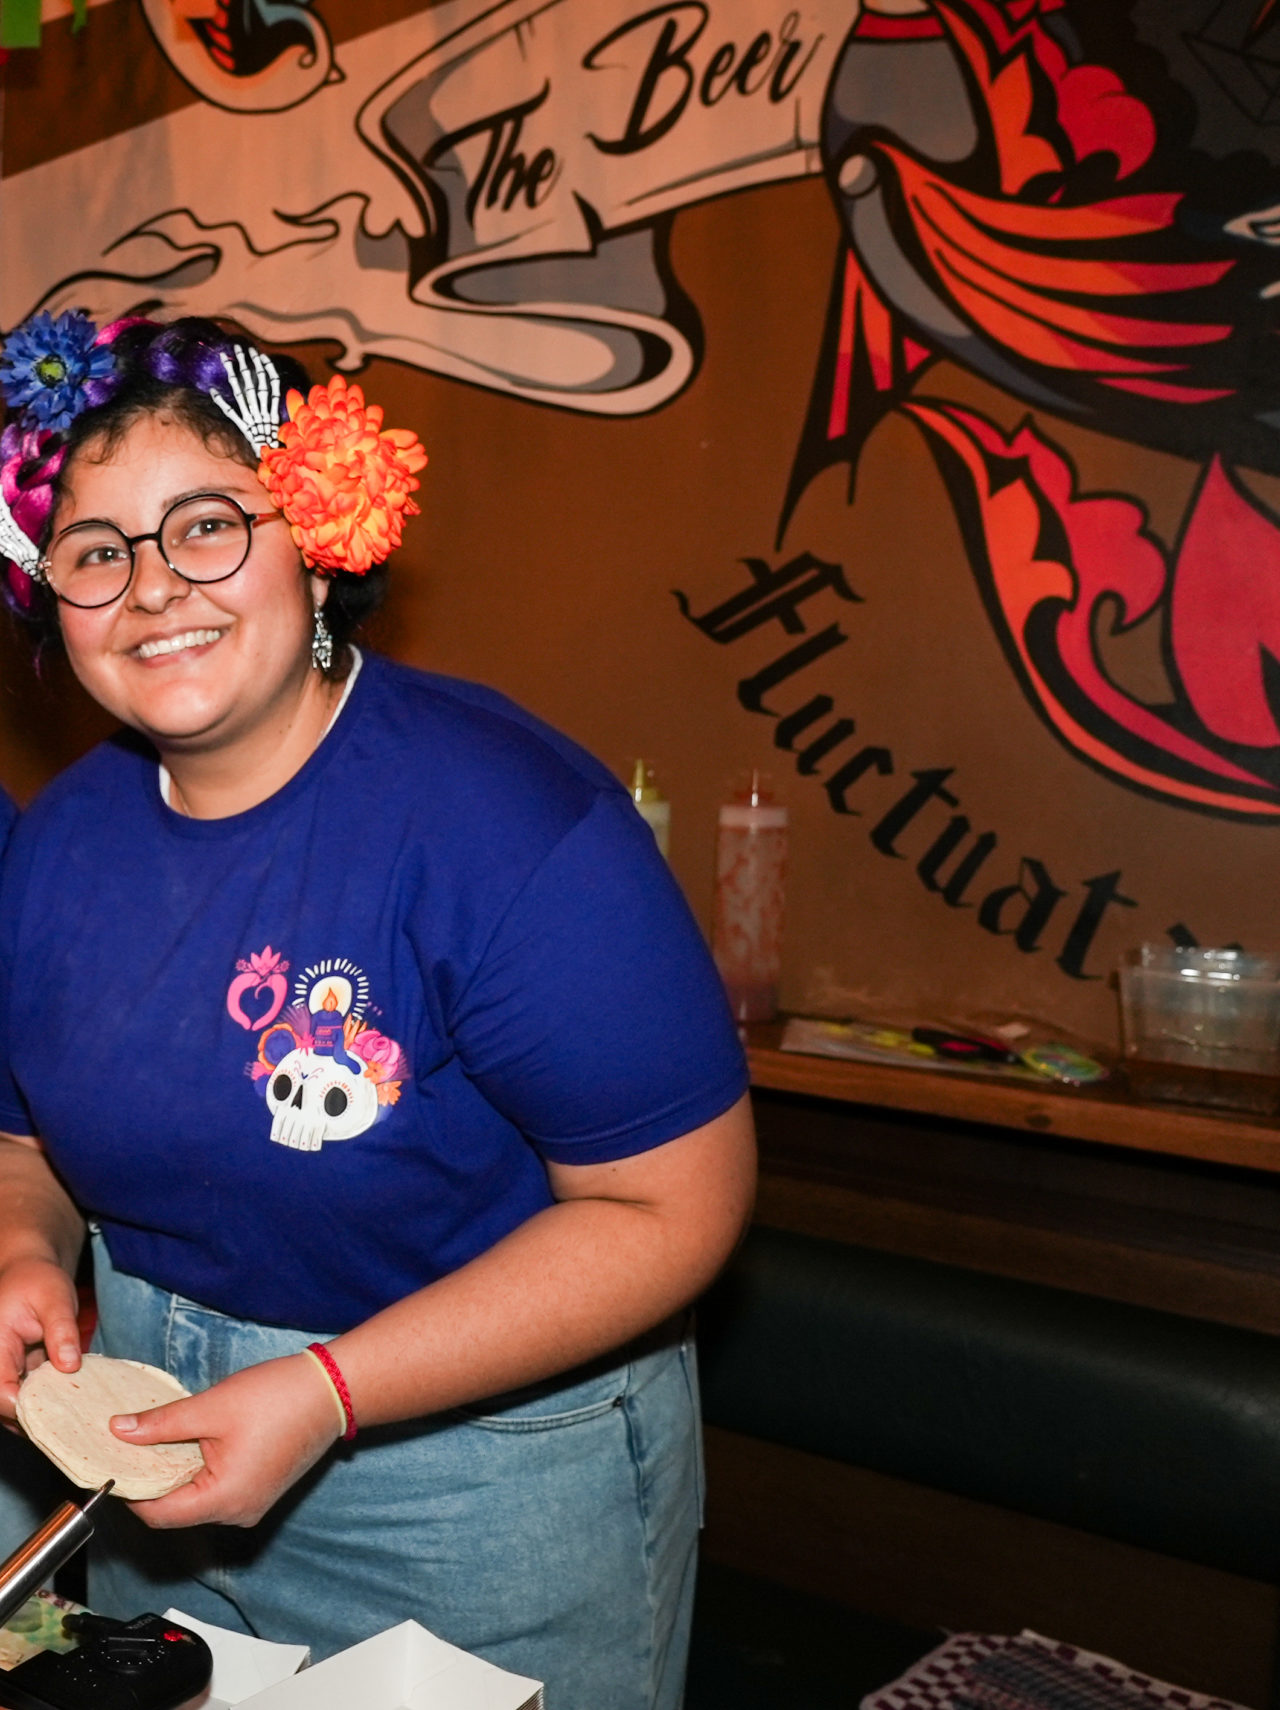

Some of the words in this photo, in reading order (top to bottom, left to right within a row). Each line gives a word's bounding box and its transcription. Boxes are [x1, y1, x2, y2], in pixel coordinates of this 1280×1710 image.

[422, 77, 562, 231] The
[582, 1, 825, 156] Beer
[669, 551, 1138, 980] Fluctuat
